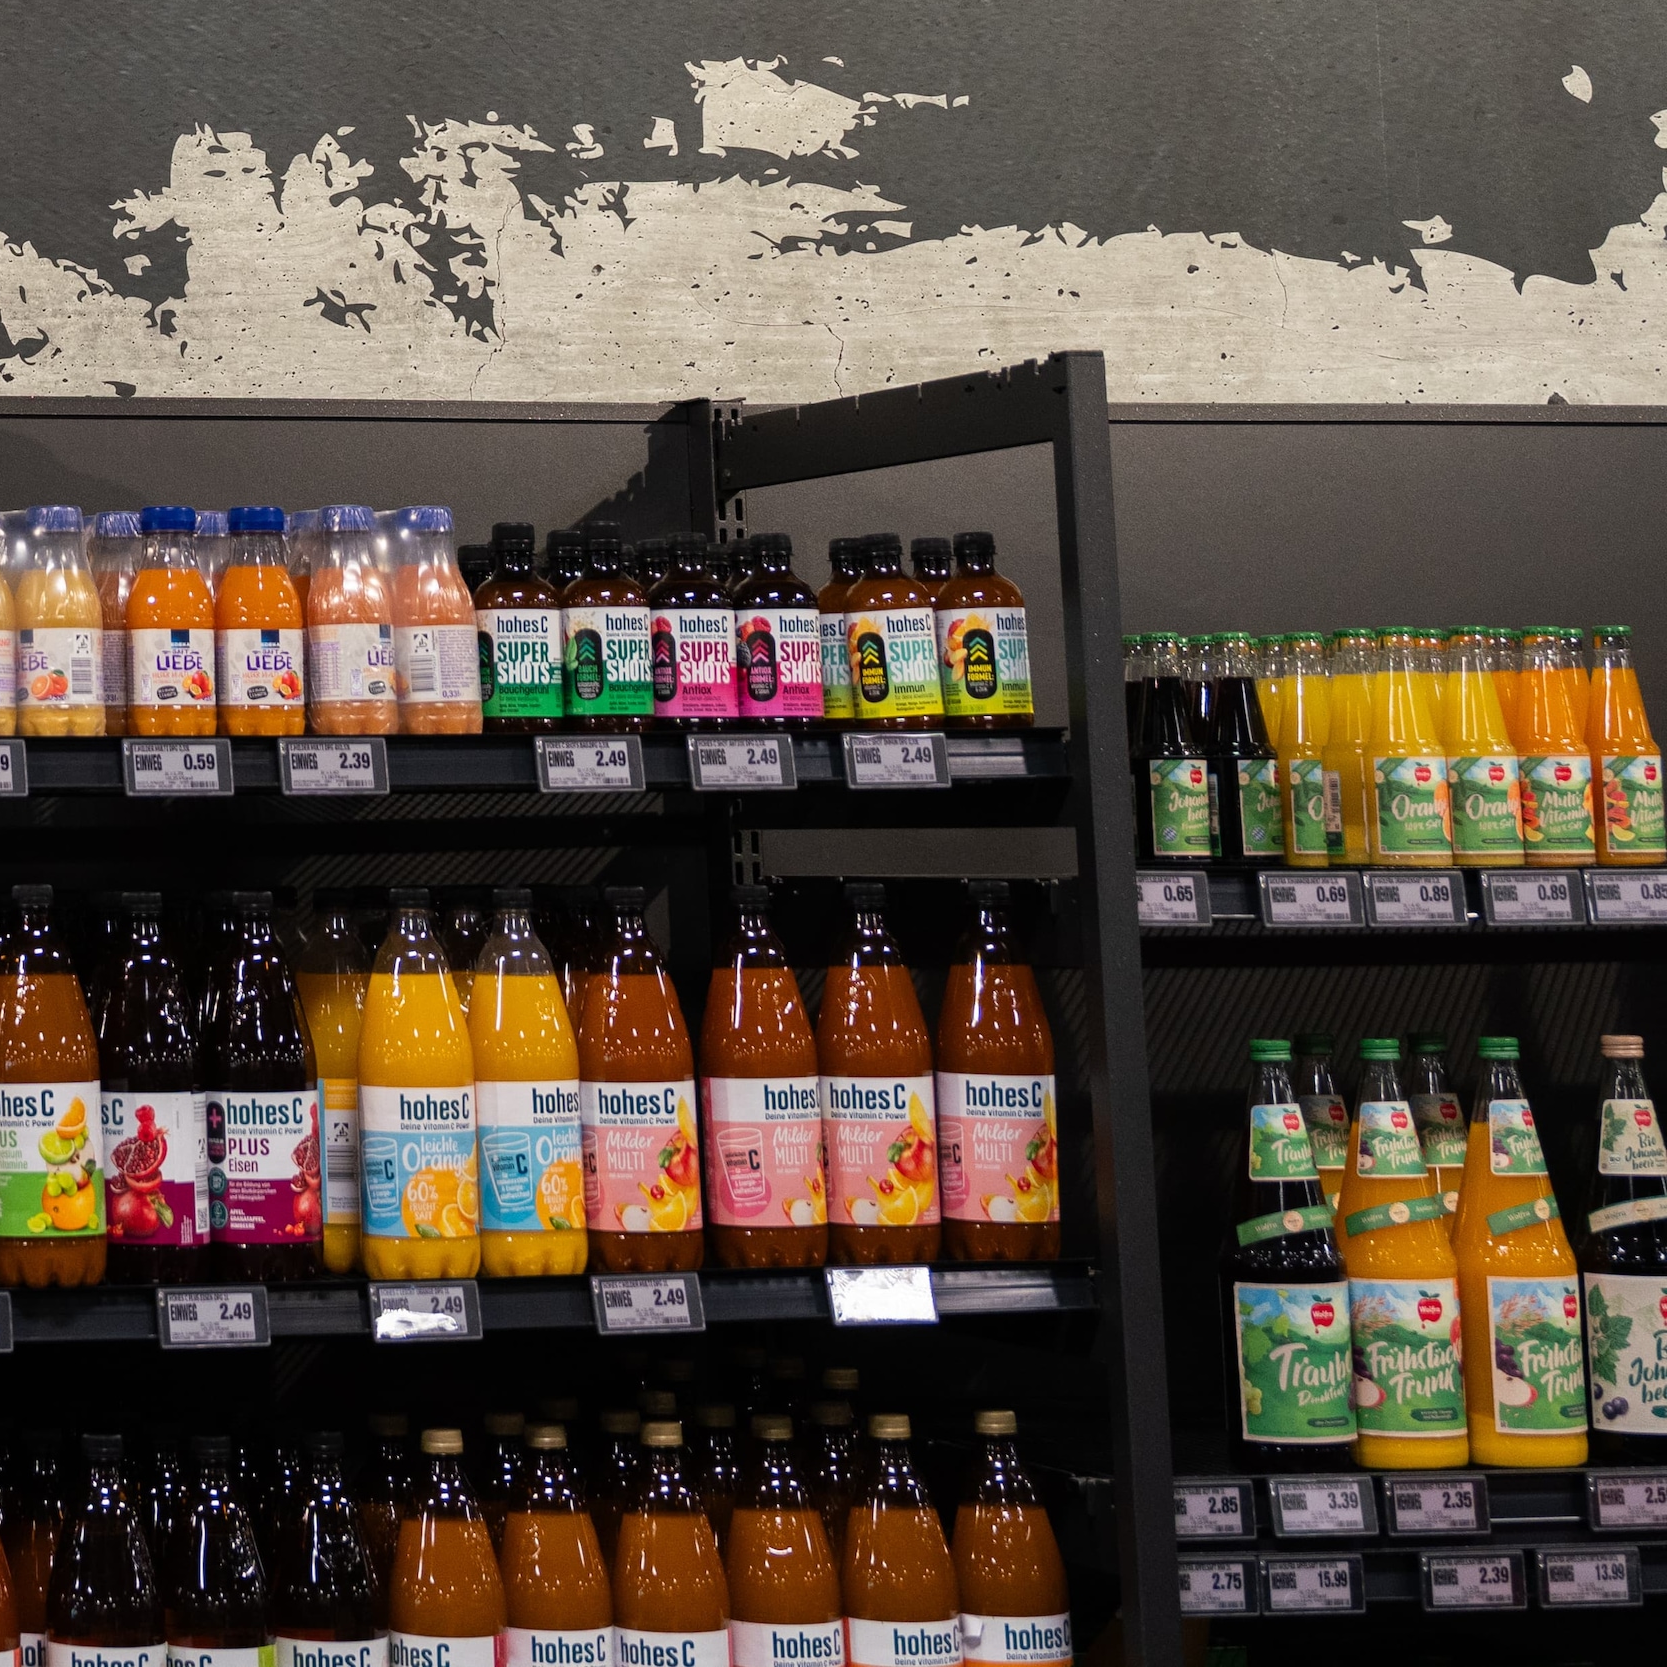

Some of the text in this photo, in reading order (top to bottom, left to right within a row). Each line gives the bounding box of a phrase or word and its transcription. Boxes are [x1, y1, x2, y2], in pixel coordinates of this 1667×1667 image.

[497, 642, 549, 663] SUPER
[680, 642, 729, 662] SUPER
[155, 654, 203, 670] LIEBE
[246, 653, 293, 670] LIEBE
[497, 662, 551, 684] SHOTS
[679, 661, 731, 684] SHOTS
[683, 684, 712, 695] Antiox
[135, 752, 215, 770] EINWEG 0.59
[339, 751, 371, 770] 2.39
[548, 748, 627, 768] EINWEG 2.49
[747, 747, 777, 765] 2.49
[855, 746, 932, 765] EINWEG 2.49
[1163, 885, 1193, 902] 0.65
[1317, 886, 1346, 902] 0.69
[1420, 885, 1450, 902] 0.89
[1537, 884, 1567, 901] 0.89
[227, 1138, 270, 1156] PLUS
[421, 1138, 459, 1154] leichte
[606, 1130, 655, 1151] Milder
[228, 1158, 259, 1174] Eisen
[607, 1149, 645, 1172] MULTI
[407, 1184, 439, 1202] 60%
[431, 1296, 463, 1315] 2.49
[653, 1288, 685, 1306] 2.49
[219, 1303, 252, 1321] 2.49
[1208, 1497, 1238, 1514] 2.85
[1328, 1492, 1359, 1510] 3.39
[1442, 1491, 1472, 1509] 2.35
[1318, 1571, 1348, 1588] 15.99
[1479, 1567, 1509, 1584] 2.39
[1595, 1563, 1625, 1581] 13.99
[1212, 1573, 1242, 1590] 2.75
